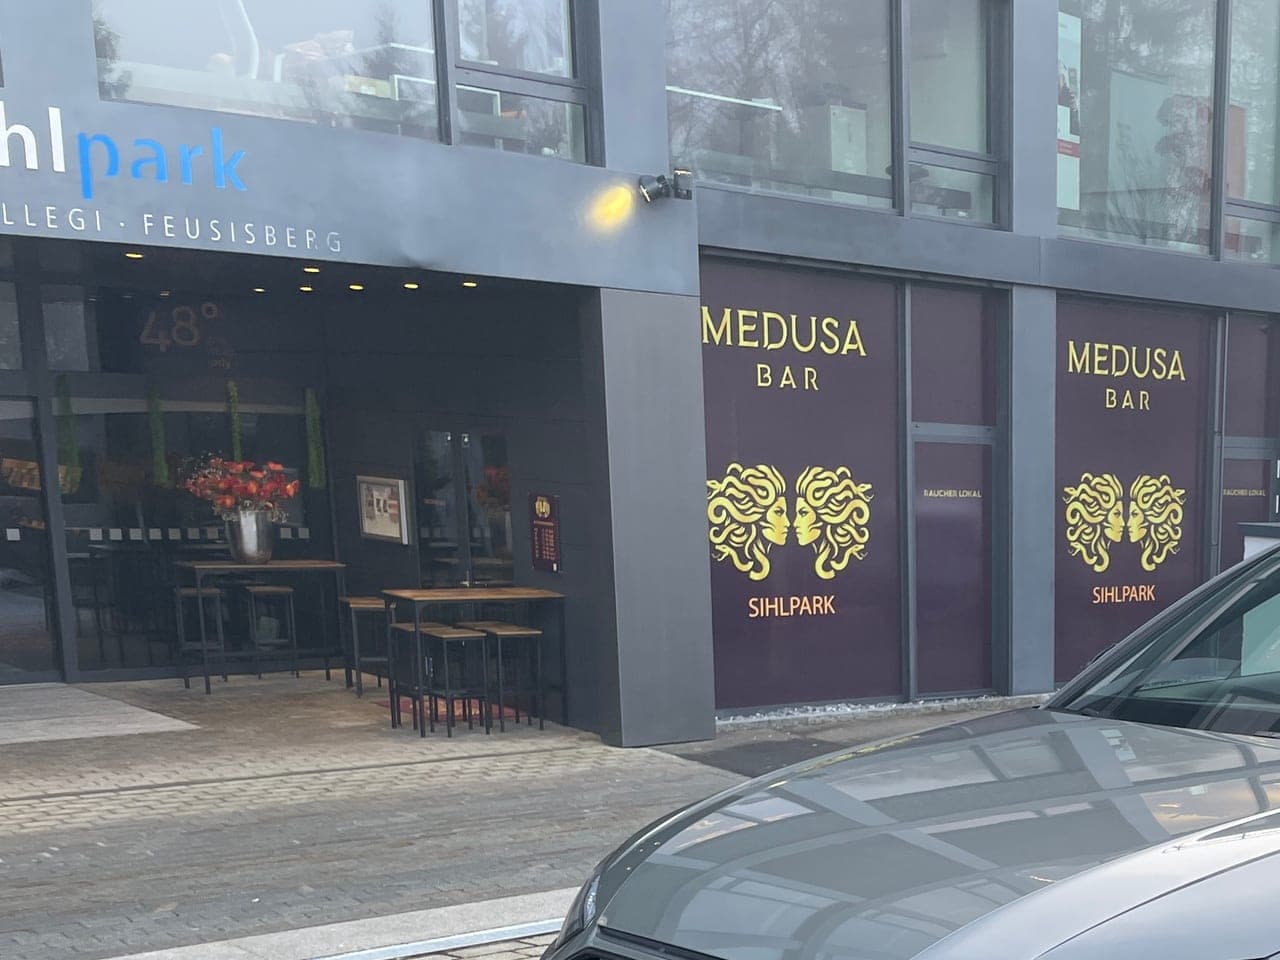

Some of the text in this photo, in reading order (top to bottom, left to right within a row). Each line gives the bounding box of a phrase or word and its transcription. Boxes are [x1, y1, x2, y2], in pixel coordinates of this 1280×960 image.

[144, 213, 341, 252] FEUSISBERG
[701, 305, 867, 356] MEDUSA
[1068, 340, 1186, 381] MEDUSA
[756, 363, 819, 391] BAR
[1105, 388, 1150, 410] BAR
[748, 595, 836, 618] SIHLPARK
[1092, 584, 1156, 604] SIHLPARK
